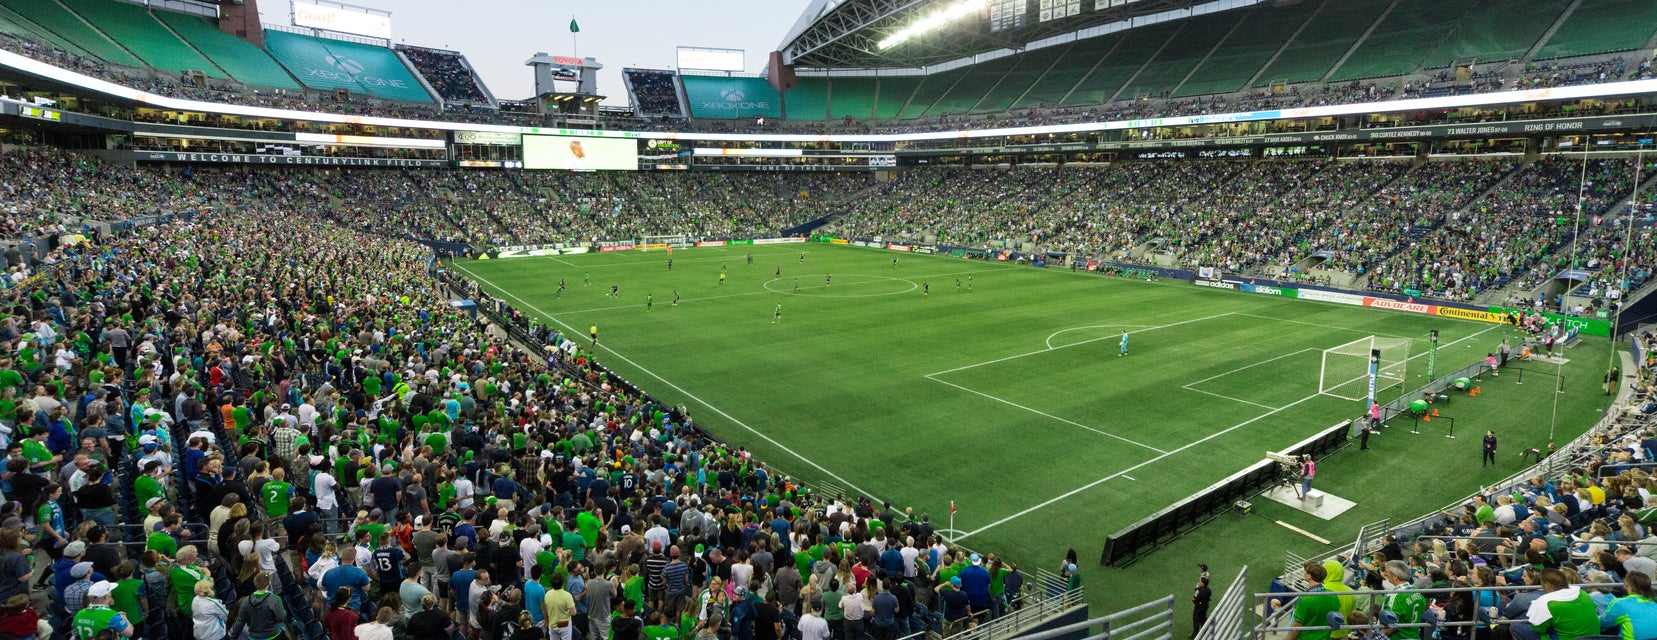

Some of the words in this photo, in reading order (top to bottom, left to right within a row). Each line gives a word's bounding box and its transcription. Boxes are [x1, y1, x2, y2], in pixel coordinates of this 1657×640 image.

[363, 76, 408, 88] ONE
[1525, 124, 1544, 132] RING
[1545, 123, 1554, 131] OF
[1556, 122, 1583, 130] HONOR
[177, 153, 250, 163] WELCOME
[286, 157, 379, 166] CENTURYLINK
[1210, 280, 1234, 289] adidas
[1255, 286, 1281, 295] slalom
[1373, 299, 1427, 312] ADVOCARE
[1440, 307, 1488, 320] Continental
[624, 478, 633, 489] 10
[270, 490, 278, 503] 2
[377, 557, 392, 571] 13
